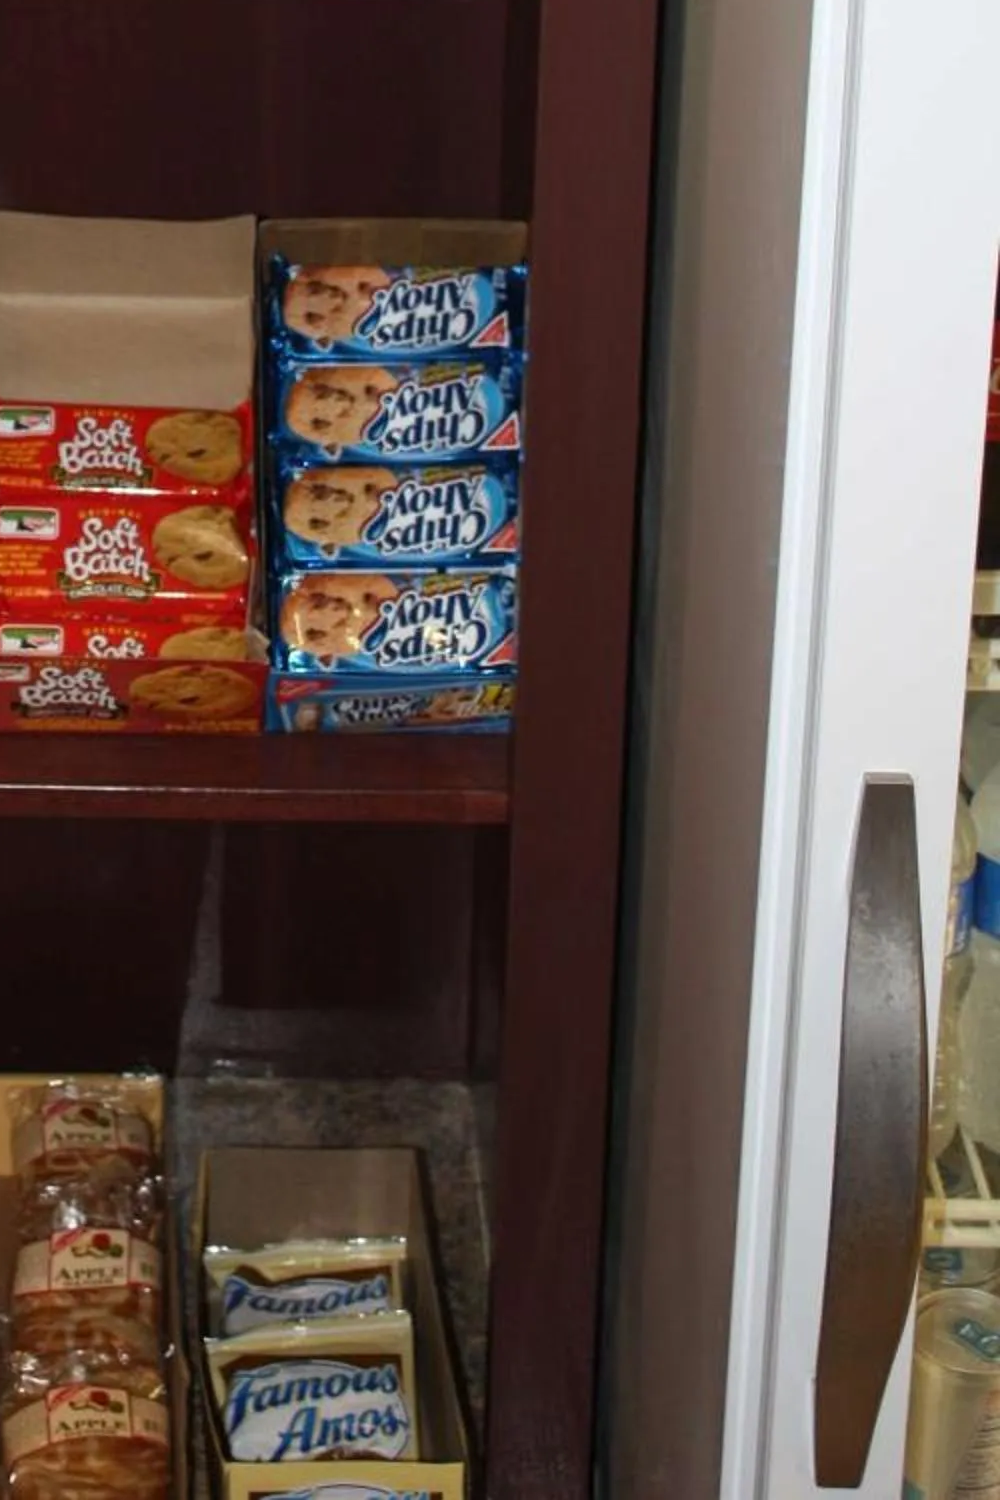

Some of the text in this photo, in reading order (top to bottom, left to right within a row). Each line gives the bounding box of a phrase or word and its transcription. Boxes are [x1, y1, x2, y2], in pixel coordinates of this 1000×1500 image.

[358, 275, 470, 337] Ahoy!
[374, 309, 475, 345] Chips
[367, 380, 474, 441] Ahoy!
[73, 417, 133, 449] Soft
[383, 410, 485, 449] Chips
[57, 442, 143, 476] Batch
[365, 482, 475, 543] Ahoy!
[383, 510, 487, 551] Chips
[81, 517, 140, 550] Soft
[63, 546, 149, 582] Batch
[364, 592, 476, 651] Ahoy!
[86, 635, 145, 659] Soft
[37, 667, 105, 693] Soft
[19, 686, 117, 712] Batch
[54, 1265, 124, 1281] APPLE
[226, 1274, 389, 1315] Famous
[229, 1364, 399, 1436] Famous
[54, 1418, 126, 1433] APPLE
[272, 1405, 400, 1463] Amos
